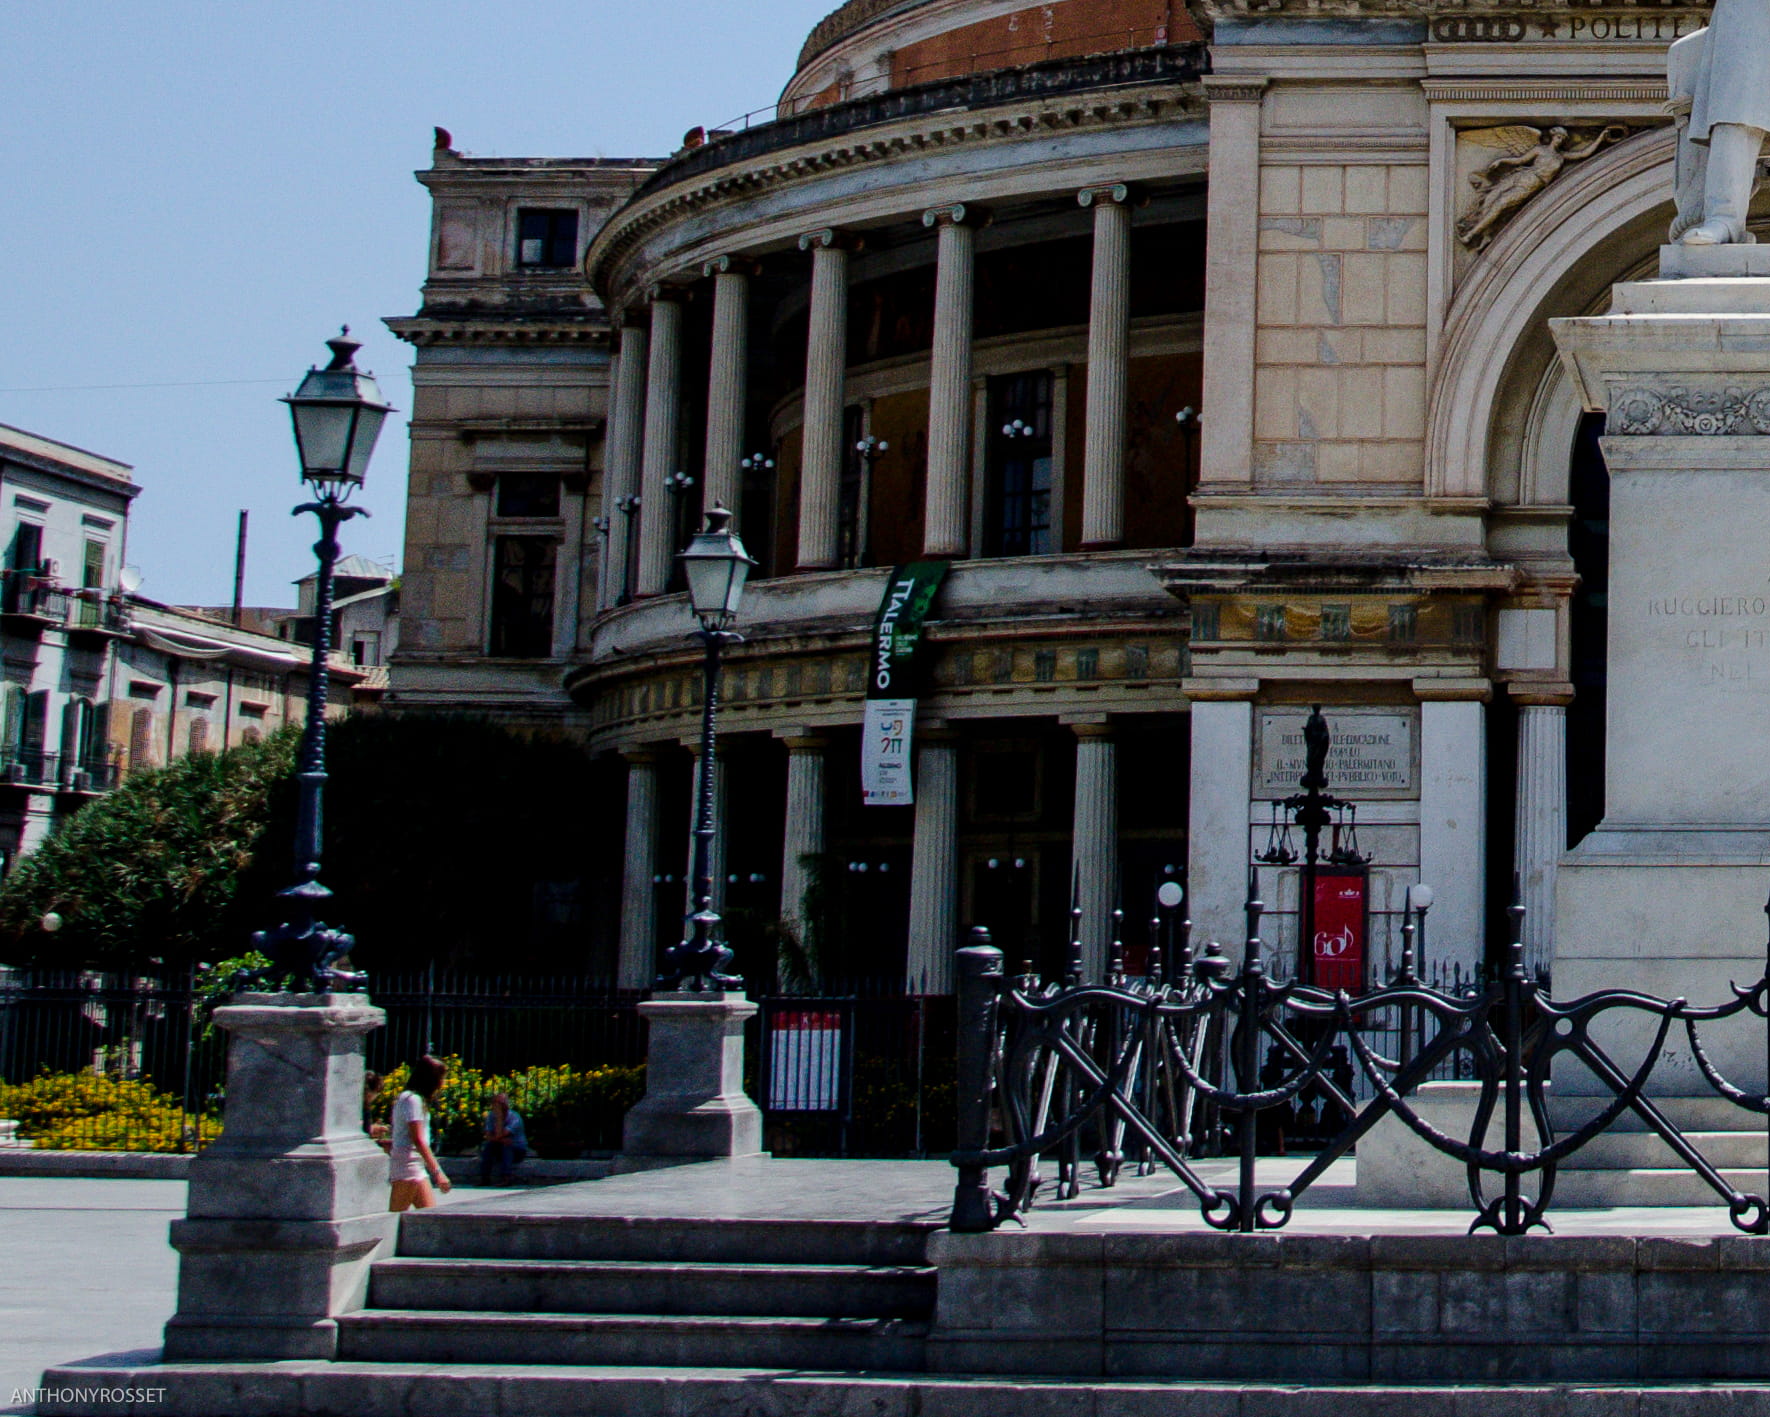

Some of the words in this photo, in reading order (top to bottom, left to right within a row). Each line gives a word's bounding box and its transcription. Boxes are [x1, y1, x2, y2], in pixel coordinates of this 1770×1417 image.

[1648, 595, 1766, 616] RUGGIERO
[1685, 629, 1725, 648] GLI
[1339, 758, 1396, 770] PALERMITANO
